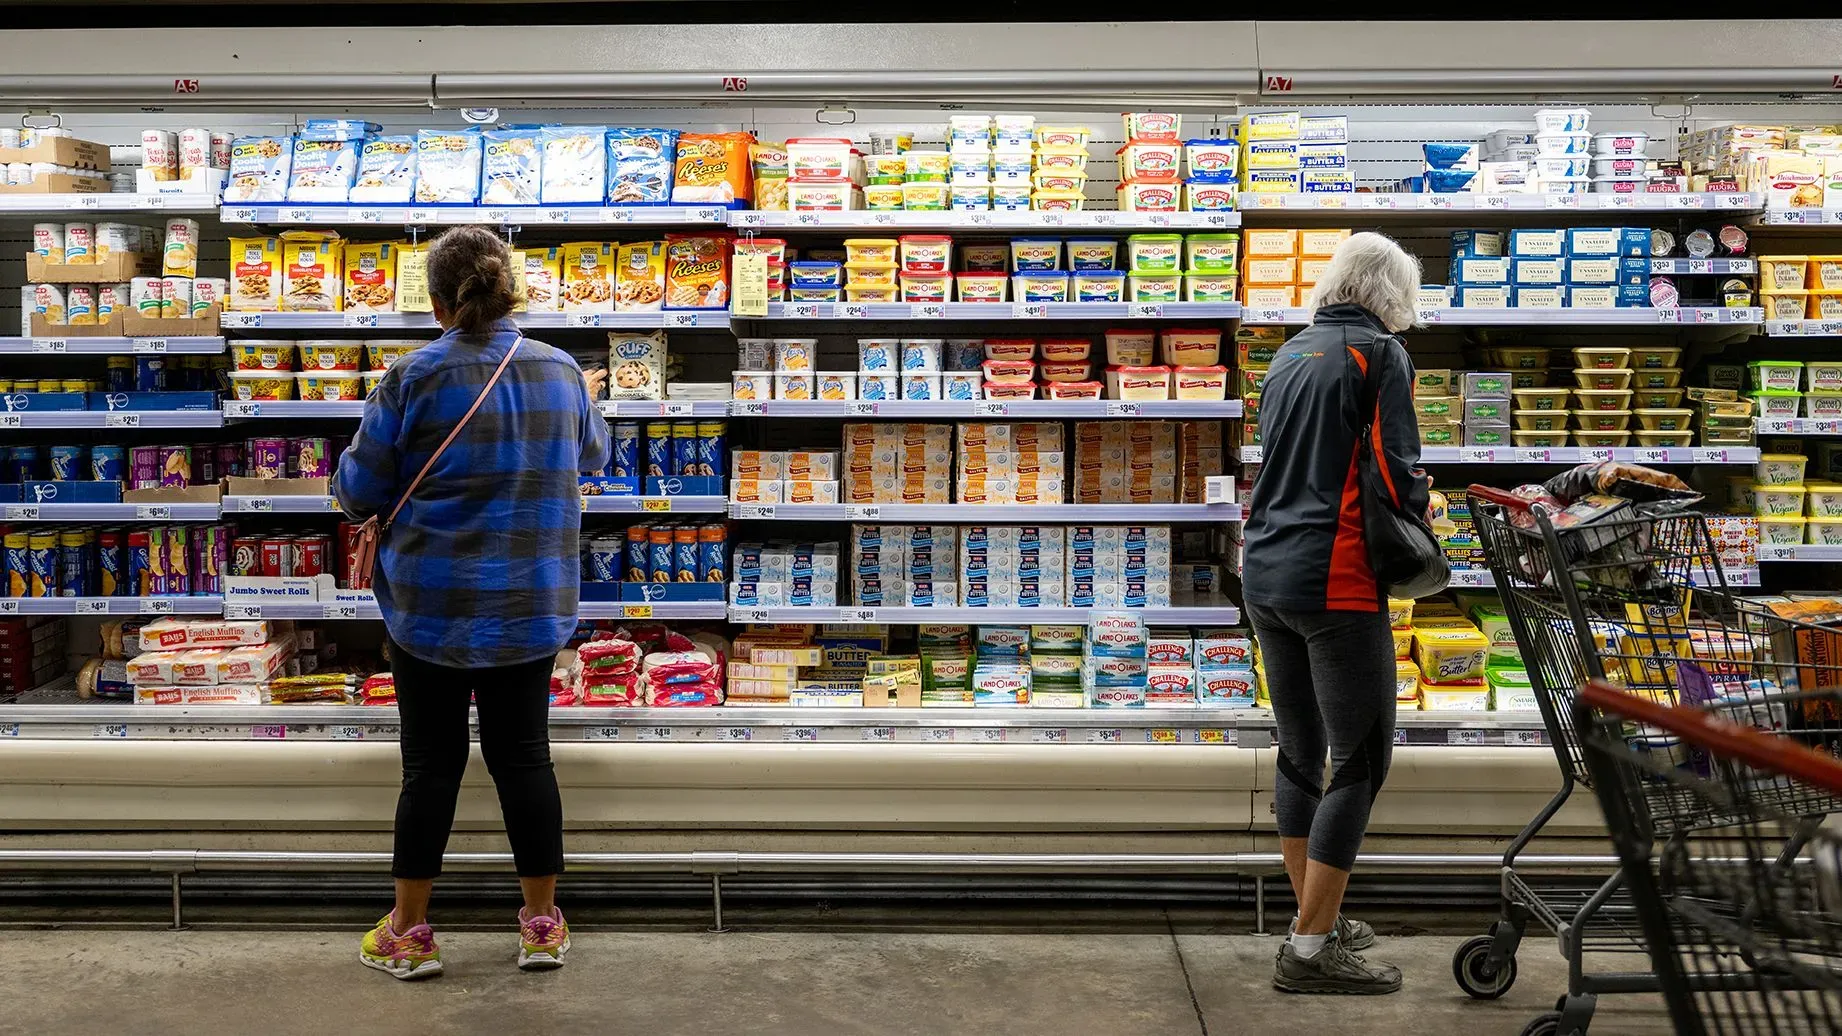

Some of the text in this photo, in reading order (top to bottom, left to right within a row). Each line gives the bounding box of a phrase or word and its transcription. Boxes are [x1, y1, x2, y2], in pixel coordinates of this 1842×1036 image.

[176, 80, 199, 92] A5
[724, 78, 747, 91] A6
[1268, 77, 1292, 90] A7
[1139, 114, 1172, 125] CHALLENGE
[1139, 152, 1172, 162] CHALLENGE
[1196, 152, 1229, 162] CHALLENGE
[678, 161, 727, 179] Reese's
[1139, 188, 1172, 200] CHALLENGE
[1196, 188, 1229, 200] CHALLENGE
[672, 260, 722, 278] Reese's
[616, 342, 652, 357] PUFF
[1770, 473, 1795, 486] Vegan
[1769, 503, 1794, 516] Vegan
[188, 628, 214, 637] English
[254, 630, 260, 638] 6
[1149, 644, 1184, 654] CHALLENGE
[1207, 646, 1242, 656] CHALLENGE
[827, 651, 872, 660] BUTTER
[1440, 660, 1472, 677] Butter!
[1152, 675, 1186, 684] CHALLENGE
[1210, 680, 1246, 690] CHALLENGE
[184, 689, 210, 697] English
